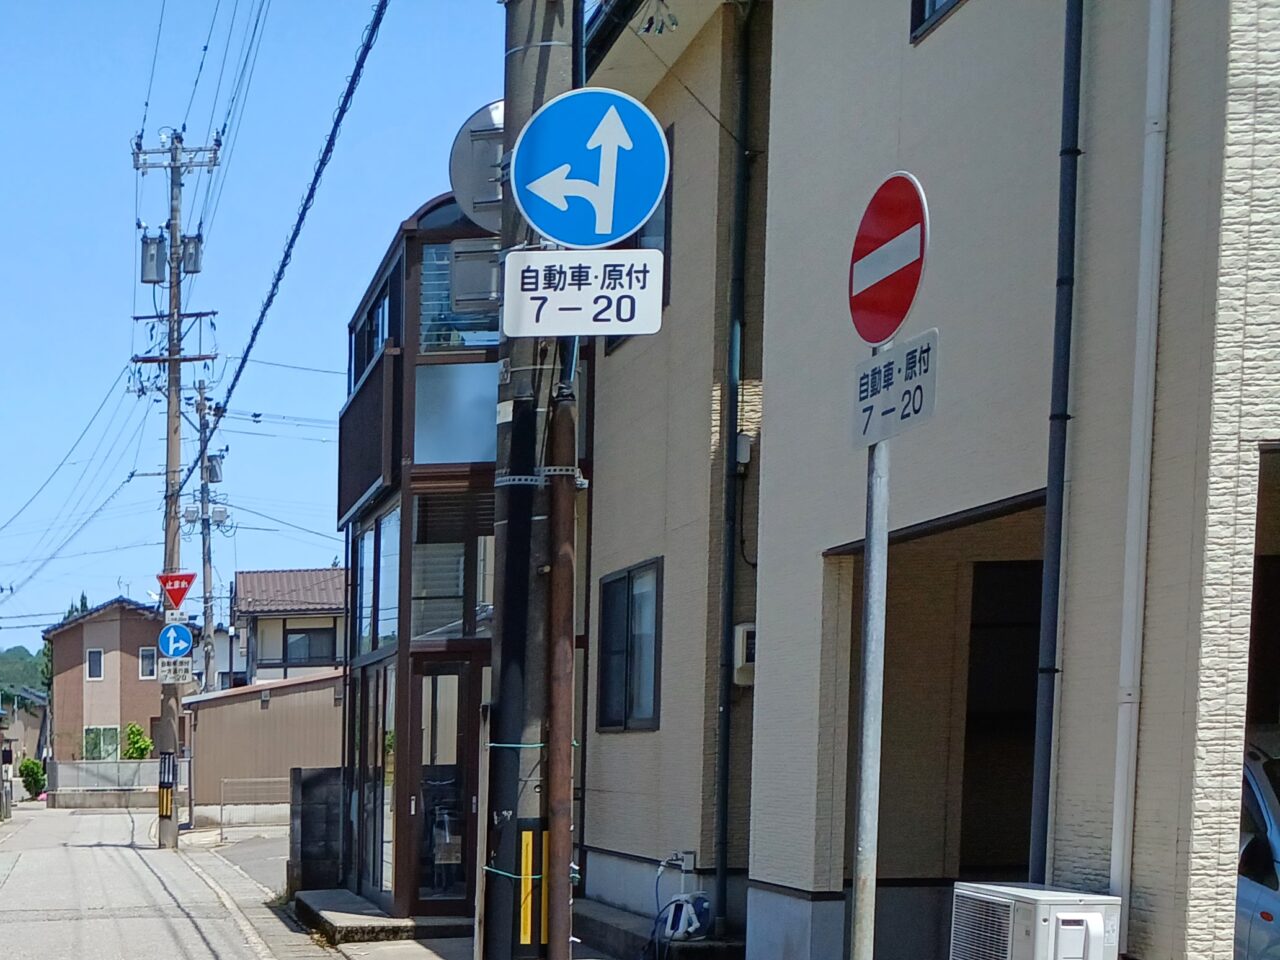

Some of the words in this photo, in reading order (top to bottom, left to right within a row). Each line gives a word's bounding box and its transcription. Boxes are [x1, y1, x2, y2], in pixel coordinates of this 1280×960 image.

[521, 263, 650, 292] 自動車・原付
[859, 342, 931, 402] 自動車・原付
